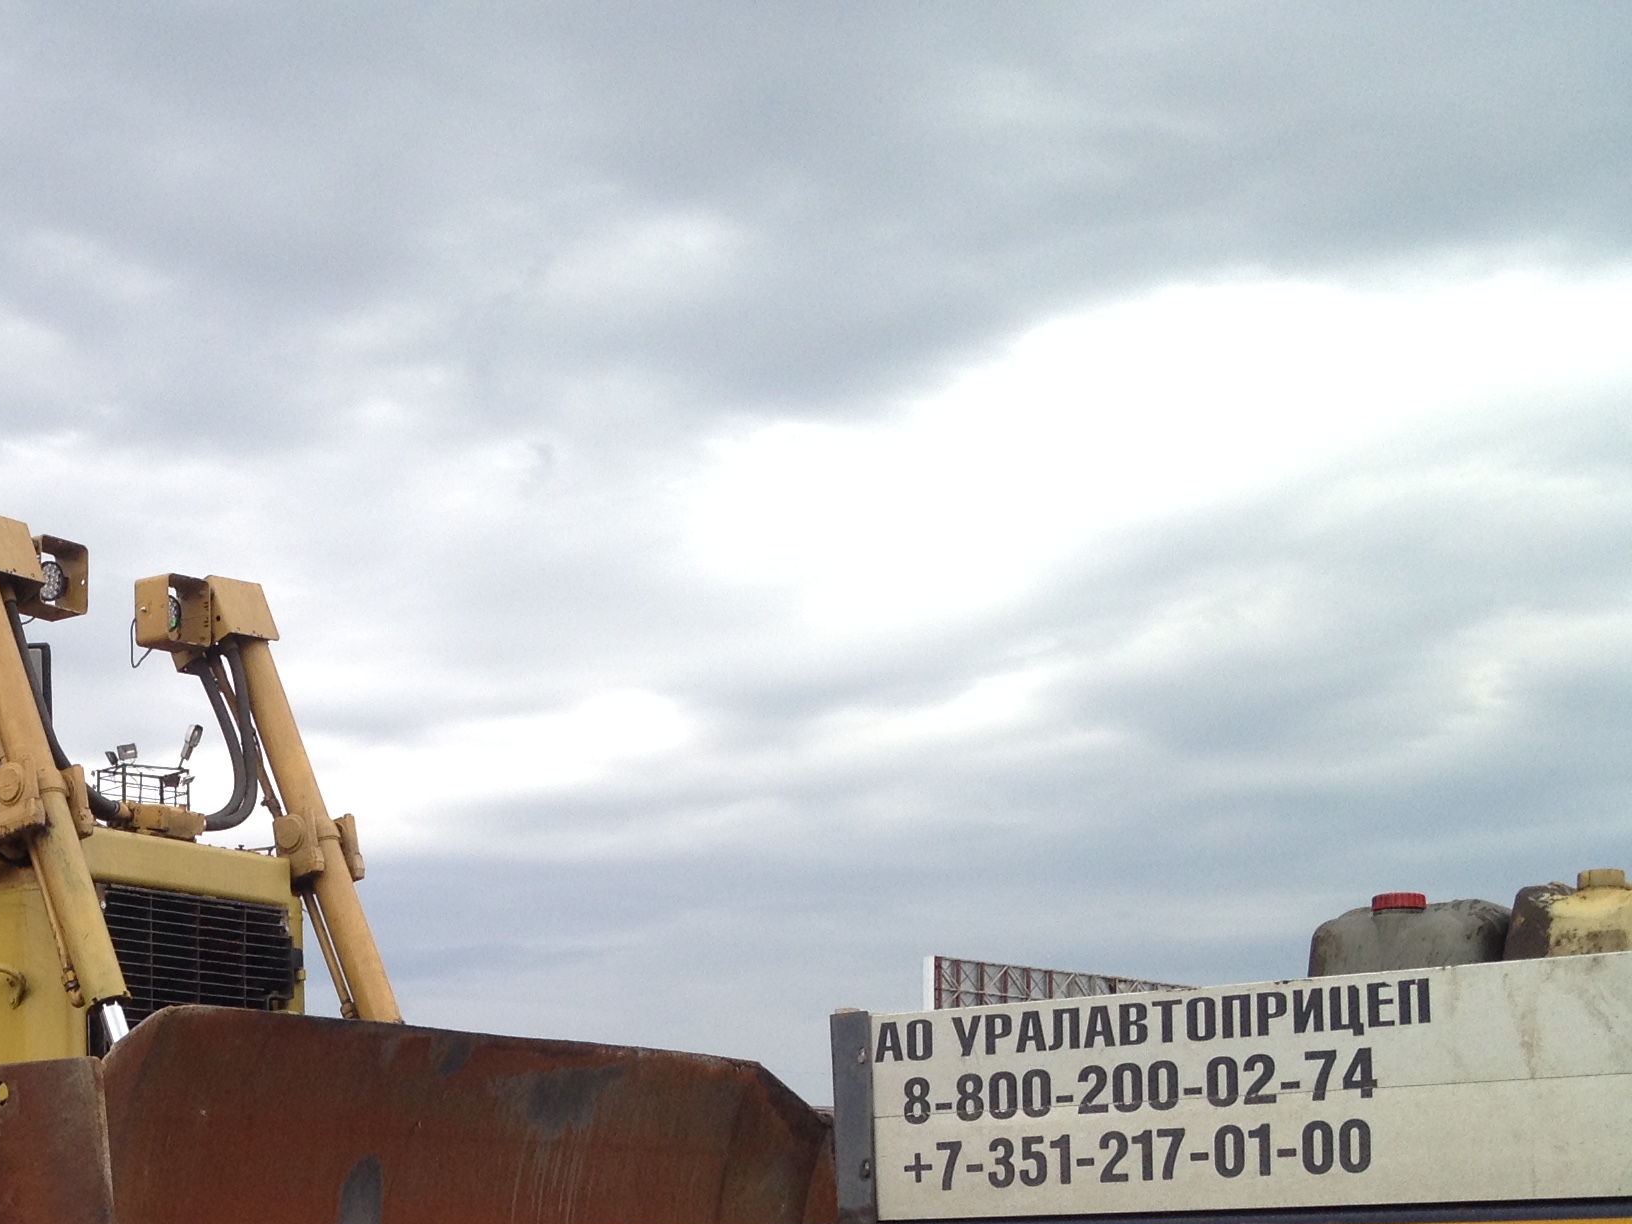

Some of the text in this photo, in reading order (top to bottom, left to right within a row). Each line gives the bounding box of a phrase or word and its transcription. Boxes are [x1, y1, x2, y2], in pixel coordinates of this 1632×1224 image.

[875, 978, 1431, 1063] АО УРАЛАВТОПРИЦЕП
[904, 1047, 1378, 1124] 8-800-200-02-74
[904, 1119, 1371, 1190] +7-351-217-01-00
